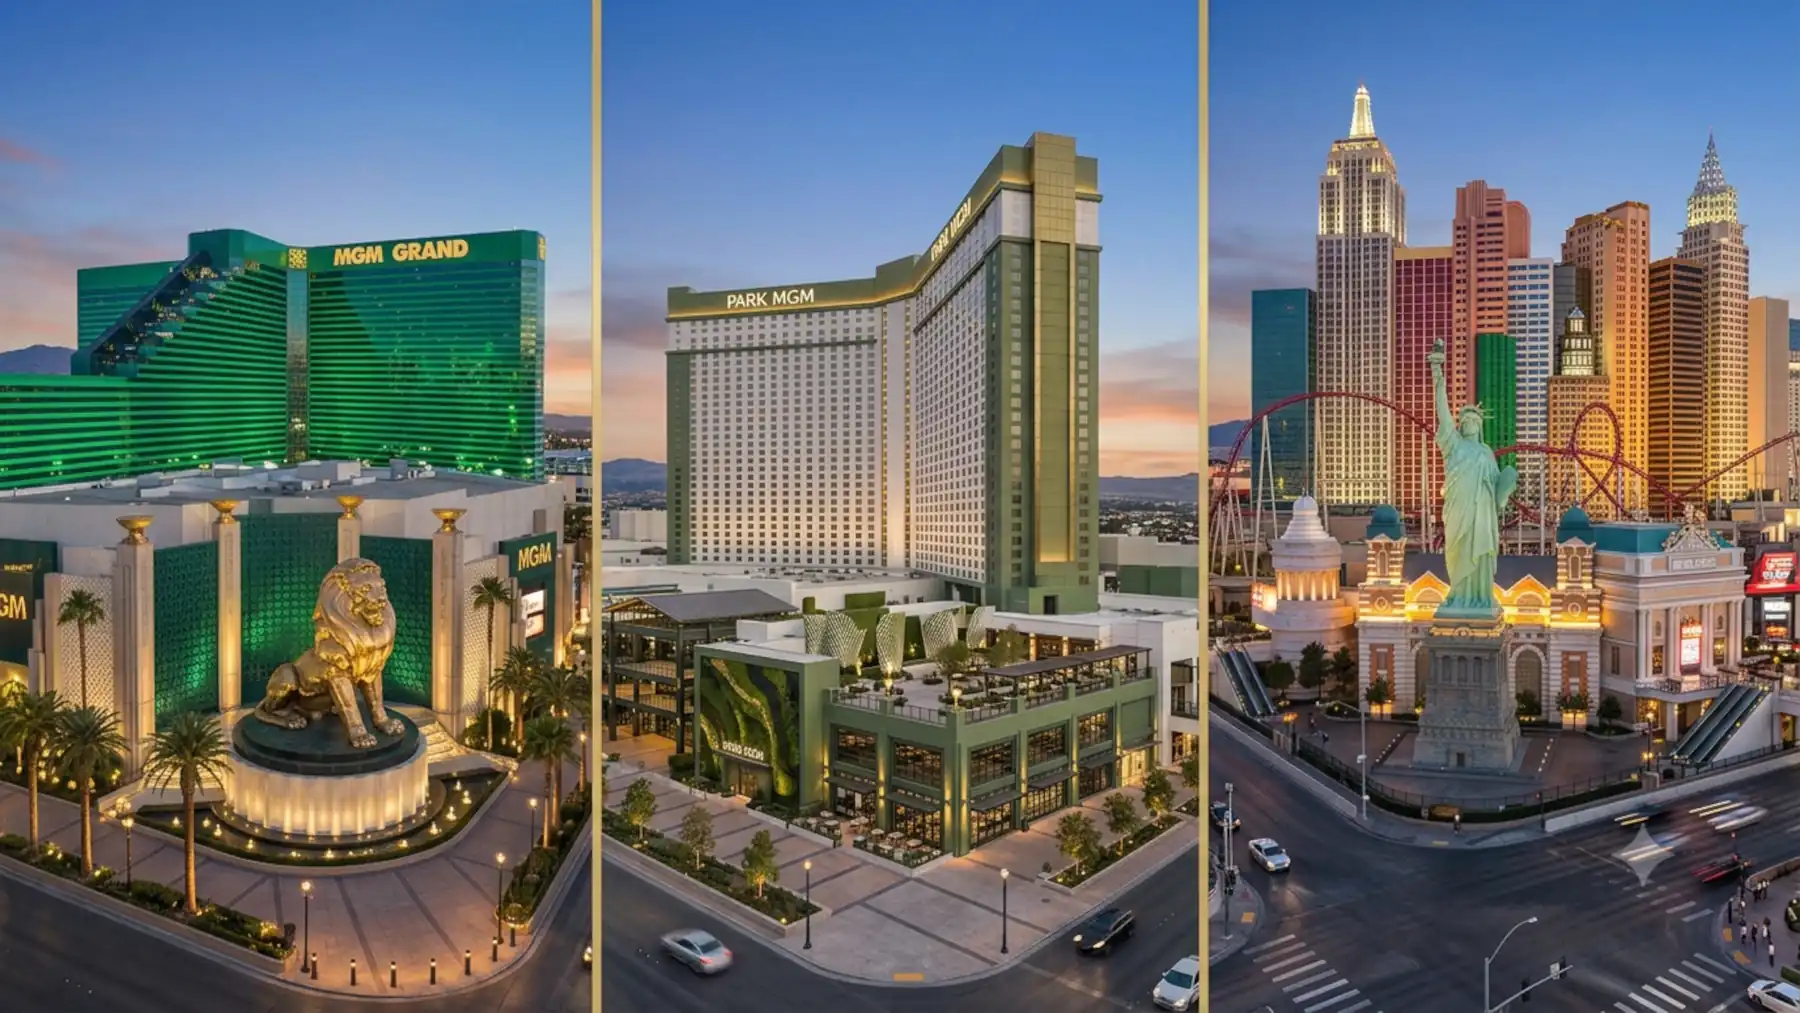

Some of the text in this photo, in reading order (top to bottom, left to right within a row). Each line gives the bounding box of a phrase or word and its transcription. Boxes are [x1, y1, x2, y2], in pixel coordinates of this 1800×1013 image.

[333, 239, 469, 266] MGM GRAND
[726, 288, 815, 309] PARK MGM
[518, 542, 552, 571] MGM
